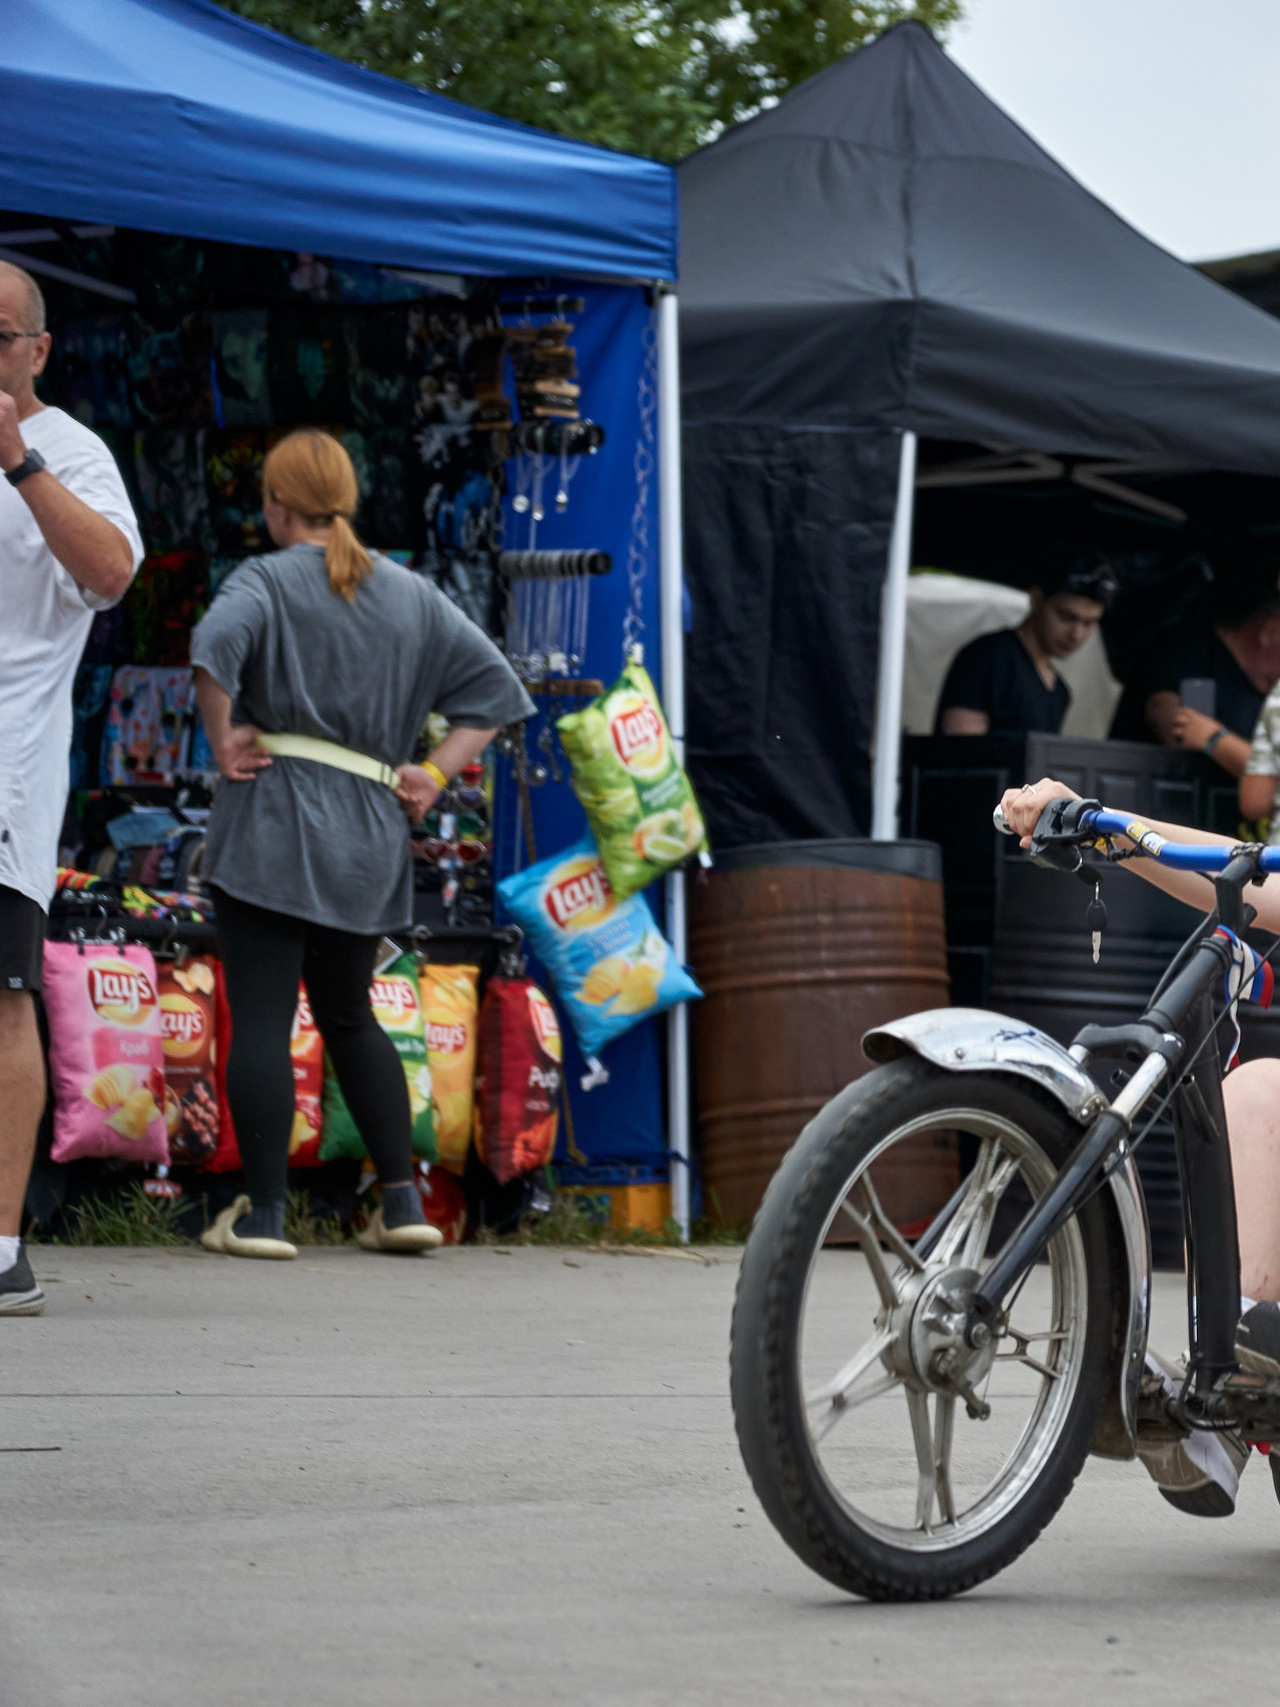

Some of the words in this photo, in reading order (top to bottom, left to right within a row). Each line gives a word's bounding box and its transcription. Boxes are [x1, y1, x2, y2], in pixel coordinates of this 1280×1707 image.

[615, 699, 661, 758] Lay's
[94, 968, 151, 1015] Lay's
[160, 1009, 203, 1043] ay's
